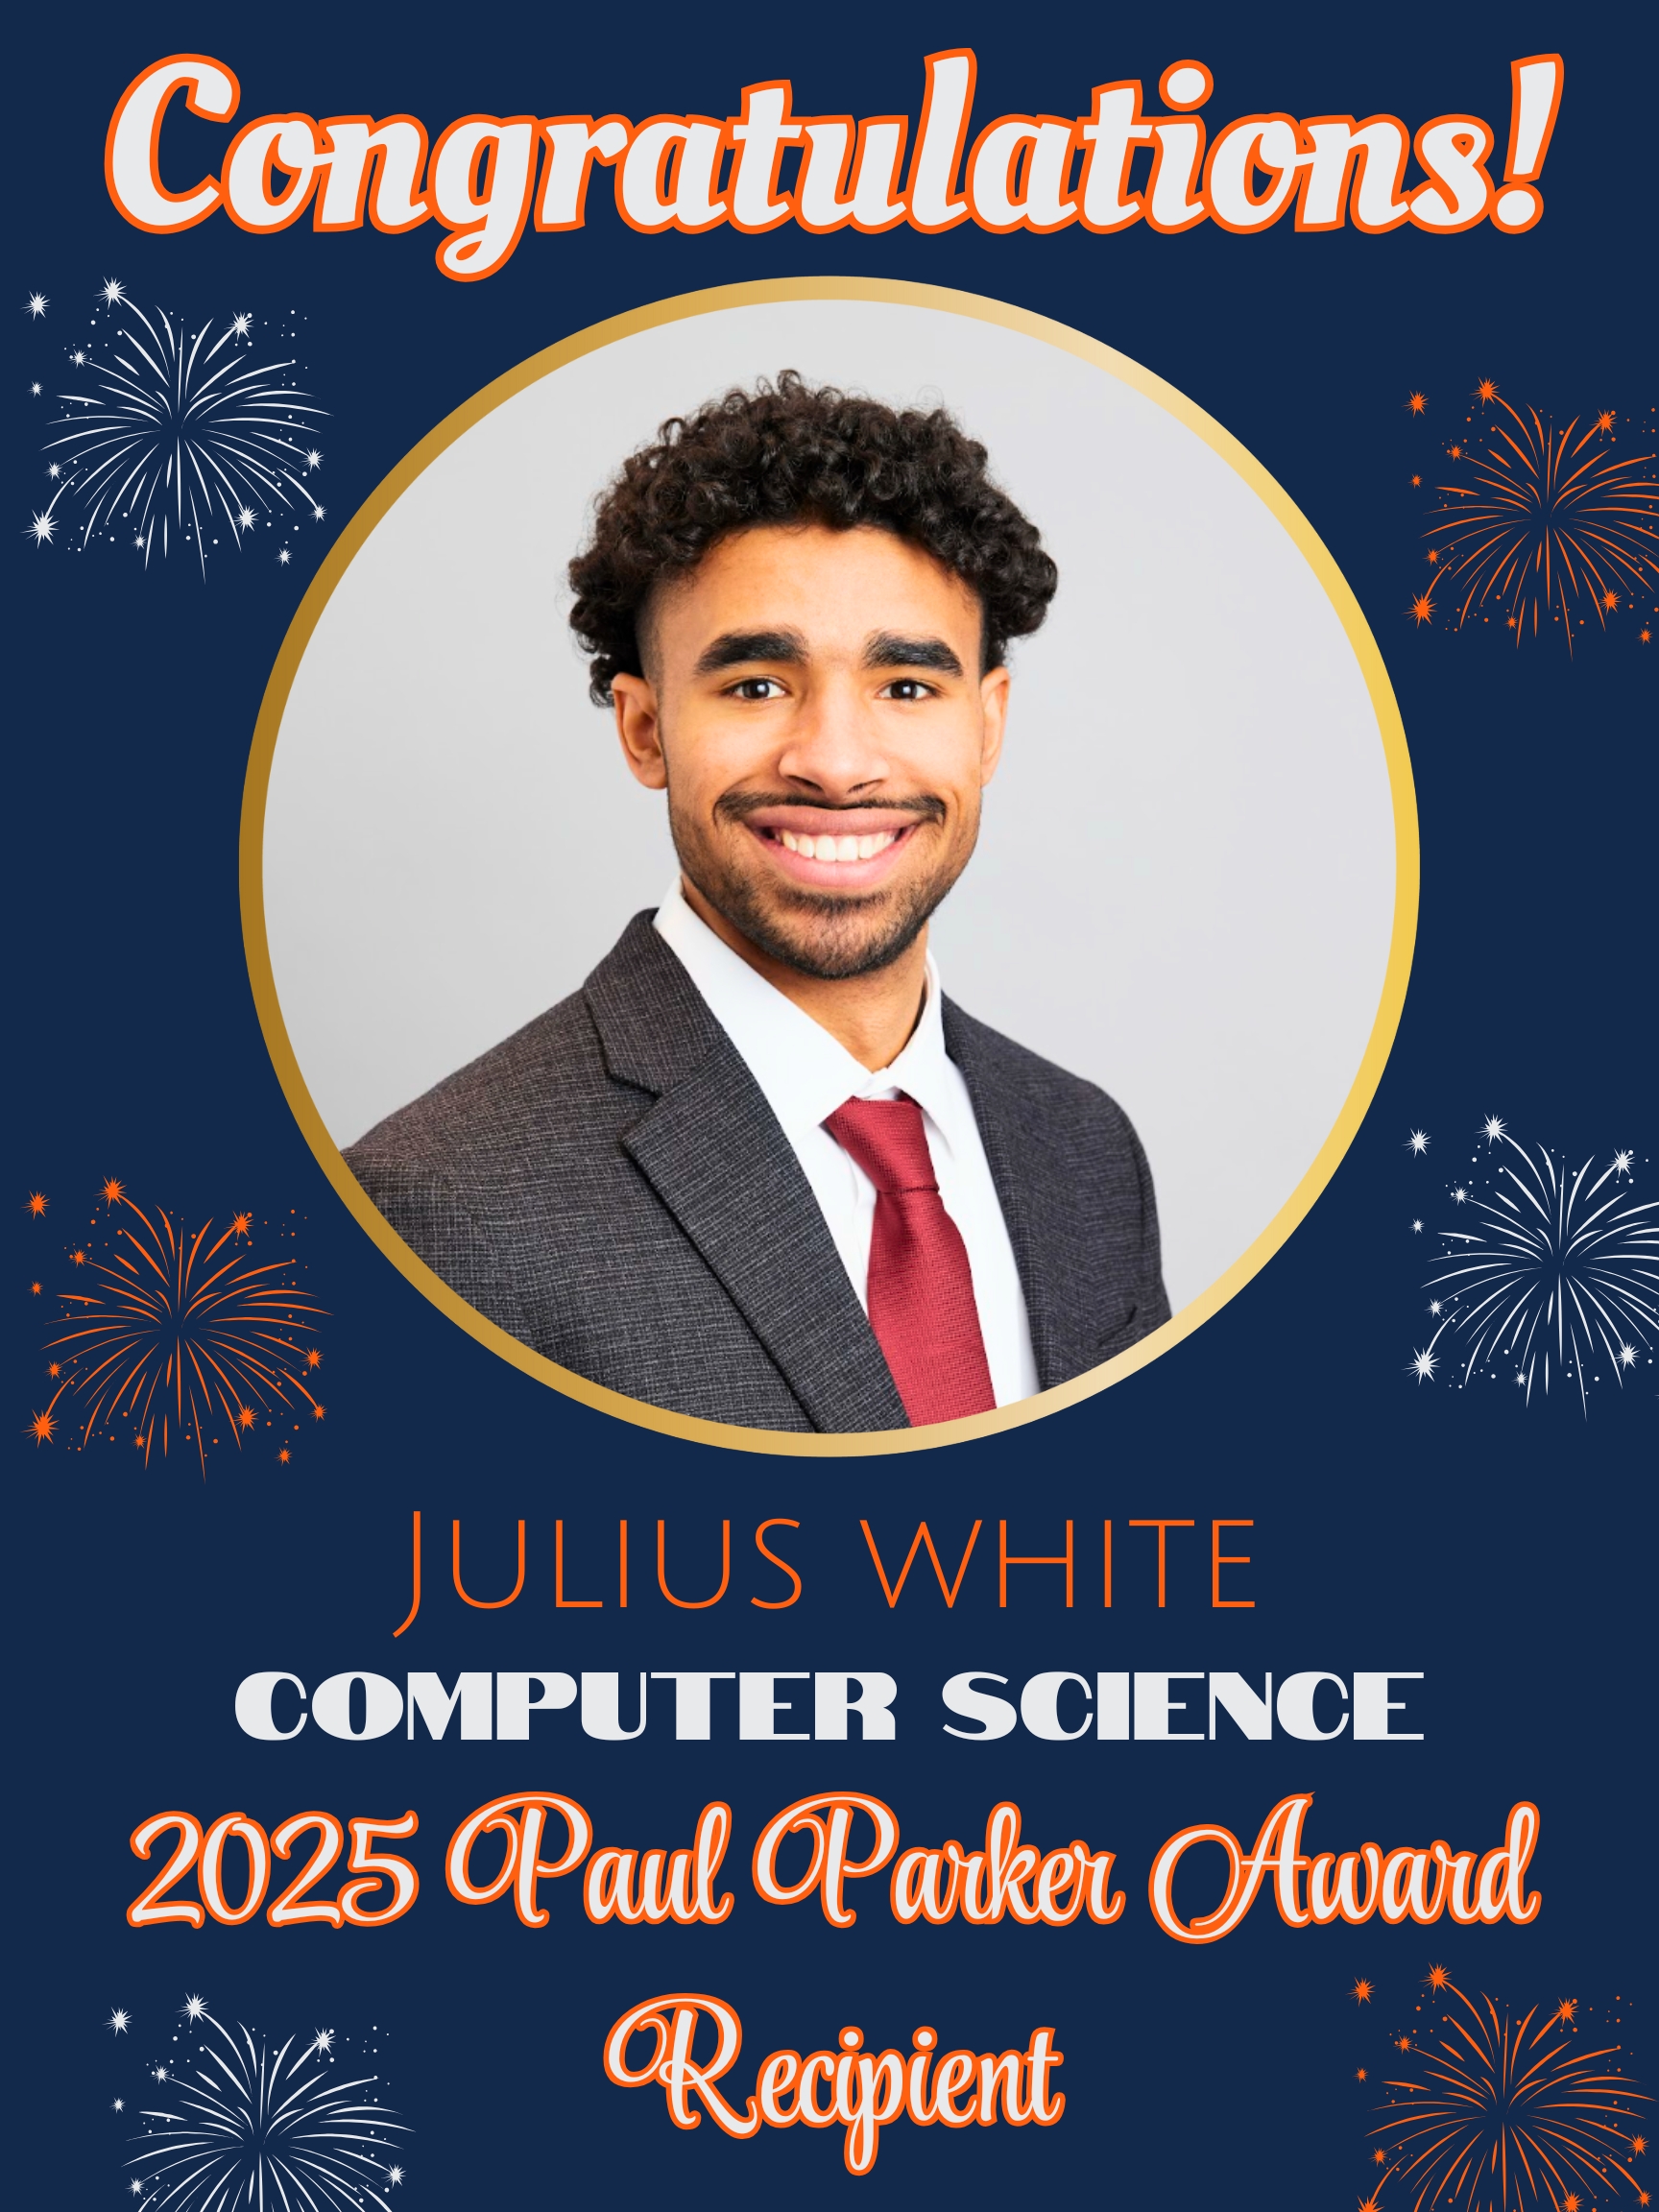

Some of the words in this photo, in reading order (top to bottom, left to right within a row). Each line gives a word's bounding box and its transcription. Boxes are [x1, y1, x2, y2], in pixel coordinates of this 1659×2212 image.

[104, 48, 1565, 282] Congratulations!
[393, 1511, 802, 1638] JULIUS
[860, 1520, 1256, 1608] WHITE
[235, 1671, 897, 1741] COMPUTER
[942, 1671, 1424, 1741] SCIENCE
[126, 1810, 420, 1930] 2025
[445, 1791, 735, 1929] Paul
[752, 1791, 1126, 1929] Parker
[1148, 1791, 1542, 1945] Award
[603, 1993, 1066, 2176] Recipient
